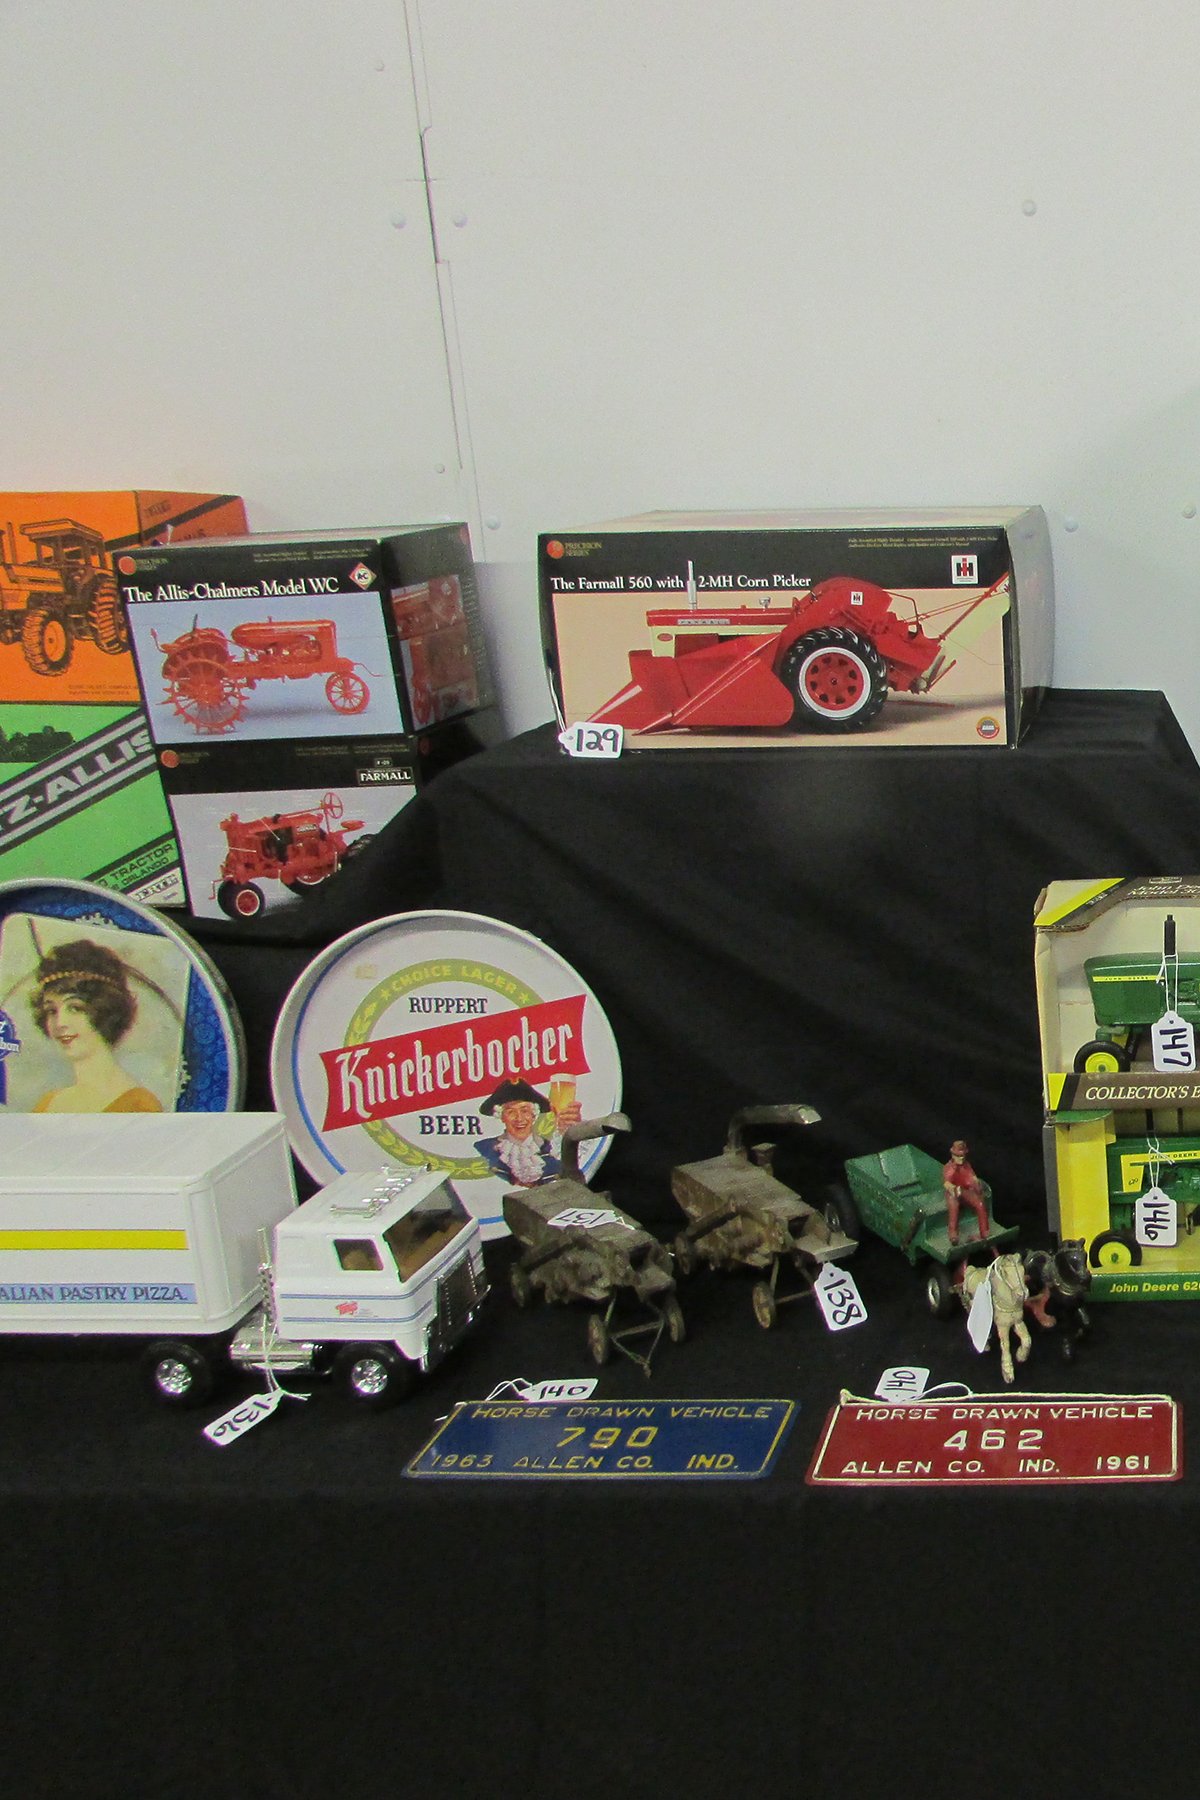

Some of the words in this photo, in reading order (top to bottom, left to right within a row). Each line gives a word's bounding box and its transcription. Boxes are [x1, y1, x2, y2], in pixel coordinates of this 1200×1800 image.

[123, 586, 153, 603] The
[156, 581, 260, 602] Allis-Chalmers
[260, 578, 306, 598] Model
[308, 576, 340, 594] WC
[551, 576, 576, 590] The
[578, 576, 624, 590] Farmall
[628, 576, 653, 589] 560
[656, 575, 684, 589] with
[697, 575, 734, 588] 2-MH
[737, 574, 769, 588] Corn
[773, 573, 812, 587] Picker
[576, 728, 620, 752] 129
[359, 770, 411, 783] FARMALL
[109, 844, 175, 881] TRACTOR
[391, 964, 452, 993] CHOICE
[460, 965, 517, 994] LAGER
[408, 996, 488, 1014] RUPPERT
[1159, 1027, 1192, 1067] 147
[334, 1014, 575, 1118] Knickerbocker
[1085, 1084, 1190, 1101] COLLECTOR'S
[419, 1114, 484, 1136] BEER
[1172, 1151, 1199, 1159] DEERE
[1128, 1178, 1139, 1186] 620
[555, 1209, 607, 1225] 137
[1142, 1202, 1171, 1241] 146
[0, 1286, 54, 1301] ALIAN
[59, 1286, 128, 1301] PASTRY
[1110, 1282, 1139, 1294] John
[1142, 1282, 1180, 1293] Deere
[823, 1278, 863, 1326] 138
[538, 1384, 589, 1400] 140
[886, 1369, 918, 1394] 140
[212, 1400, 271, 1437] 136
[470, 1405, 558, 1419] HORSE
[566, 1405, 656, 1419] DRAWN
[669, 1405, 773, 1419] VEHICLE
[855, 1407, 939, 1422] HORSE
[951, 1406, 1041, 1421] DRAWN
[1048, 1405, 1154, 1420] VEHICLE
[555, 1426, 660, 1449] 790
[942, 1428, 1045, 1452] 462
[430, 1453, 494, 1469] 1963
[513, 1454, 601, 1469] ALLEN
[616, 1454, 655, 1469] CO.
[685, 1453, 739, 1470] IND.
[841, 1459, 932, 1475] ALLEN
[947, 1459, 986, 1475] CO.
[1018, 1458, 1061, 1474] IND.
[1095, 1454, 1151, 1471] 1961
